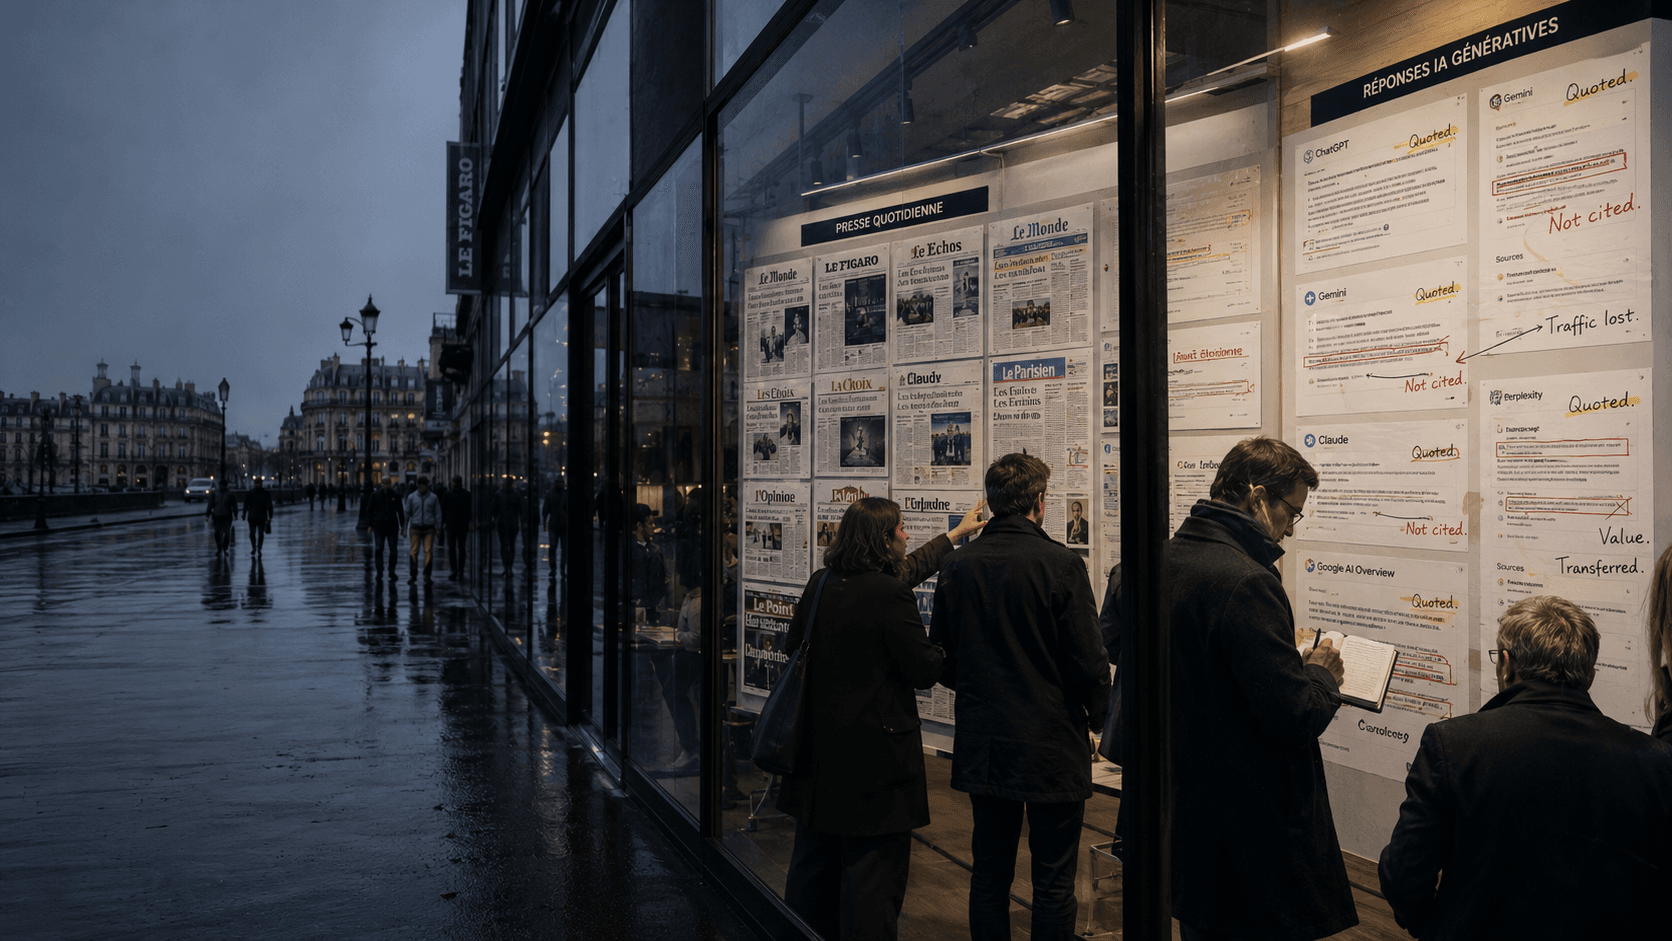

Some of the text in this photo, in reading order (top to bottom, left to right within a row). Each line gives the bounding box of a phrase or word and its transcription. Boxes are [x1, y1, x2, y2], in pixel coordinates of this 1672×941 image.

[1363, 17, 1559, 98] RÉPONSES IA GÉNÉRATIVES
[1566, 68, 1633, 101] Quoted.
[1504, 87, 1533, 103] Gemini
[1409, 123, 1456, 149] Quoted.
[1315, 139, 1350, 158] ChatGPT
[458, 157, 473, 277] LE FIGARO
[836, 201, 943, 234] PRESSE QUOTIDIENNE
[1549, 212, 1582, 235] Not
[1588, 192, 1641, 223] cited.
[1011, 217, 1068, 241] Le Monde
[927, 240, 962, 257] Echos
[1495, 253, 1524, 263] Sources
[825, 255, 879, 274] LE FIGARO
[759, 268, 798, 285] Le Monde
[1318, 287, 1347, 301] Gemini
[1415, 280, 1459, 301] Quoted.
[1545, 314, 1597, 336] Traffic
[1604, 308, 1639, 326] lost.
[1002, 363, 1056, 380] Le Parisien
[1404, 370, 1467, 393] Not cited.
[1568, 391, 1635, 413] Quoted.
[1318, 435, 1349, 445] Claude
[1411, 443, 1457, 460] Quoted.
[1406, 521, 1467, 536] Not cited.
[1599, 526, 1650, 545] Value.
[1317, 562, 1395, 578] Google AI Overview
[1496, 562, 1525, 572] Sources
[1555, 556, 1644, 577] Transferred.
[753, 597, 765, 612] Le
[1411, 593, 1458, 609] Quoted.
